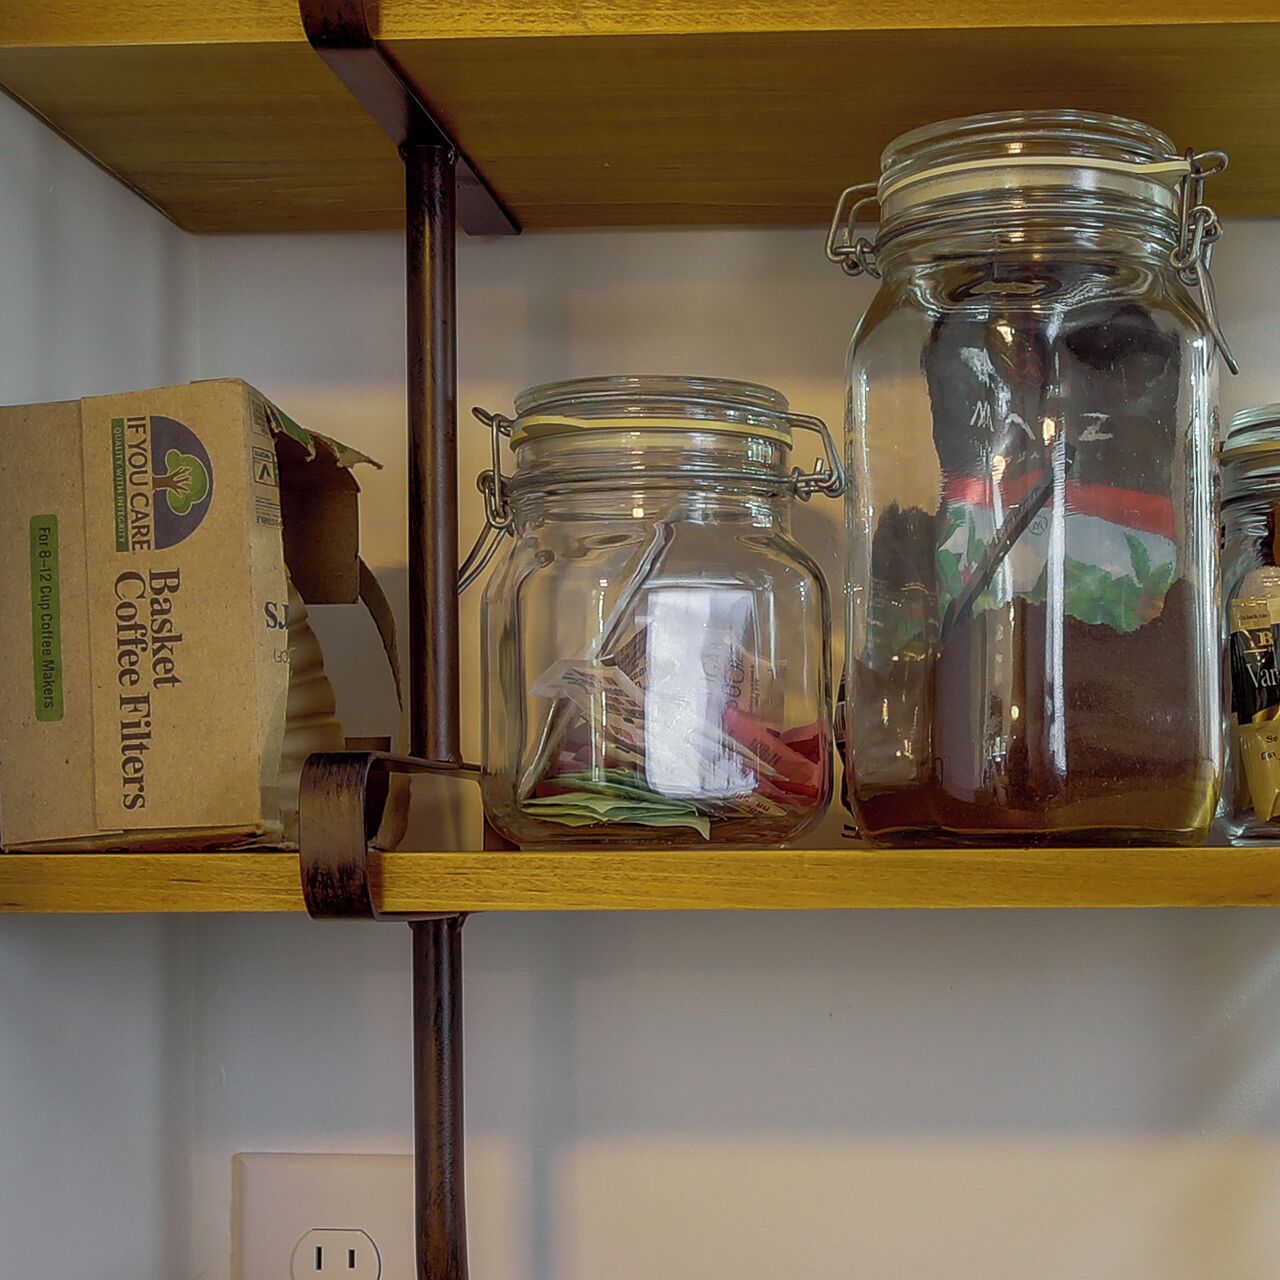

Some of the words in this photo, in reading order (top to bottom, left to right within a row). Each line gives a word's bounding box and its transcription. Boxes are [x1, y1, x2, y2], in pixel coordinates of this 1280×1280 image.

[113, 427, 124, 466] QUALITY
[126, 416, 147, 435] IF
[115, 467, 125, 494] WITH
[126, 438, 149, 488] YOU
[38, 527, 51, 547] For
[116, 495, 127, 544] INTEGRITY
[130, 491, 151, 552] CARE
[38, 585, 53, 610] Cup
[41, 613, 54, 656] Coffee
[114, 571, 149, 688] Coffee
[149, 567, 183, 689] Basket
[42, 659, 56, 709] Makers
[119, 691, 152, 810] Filters
